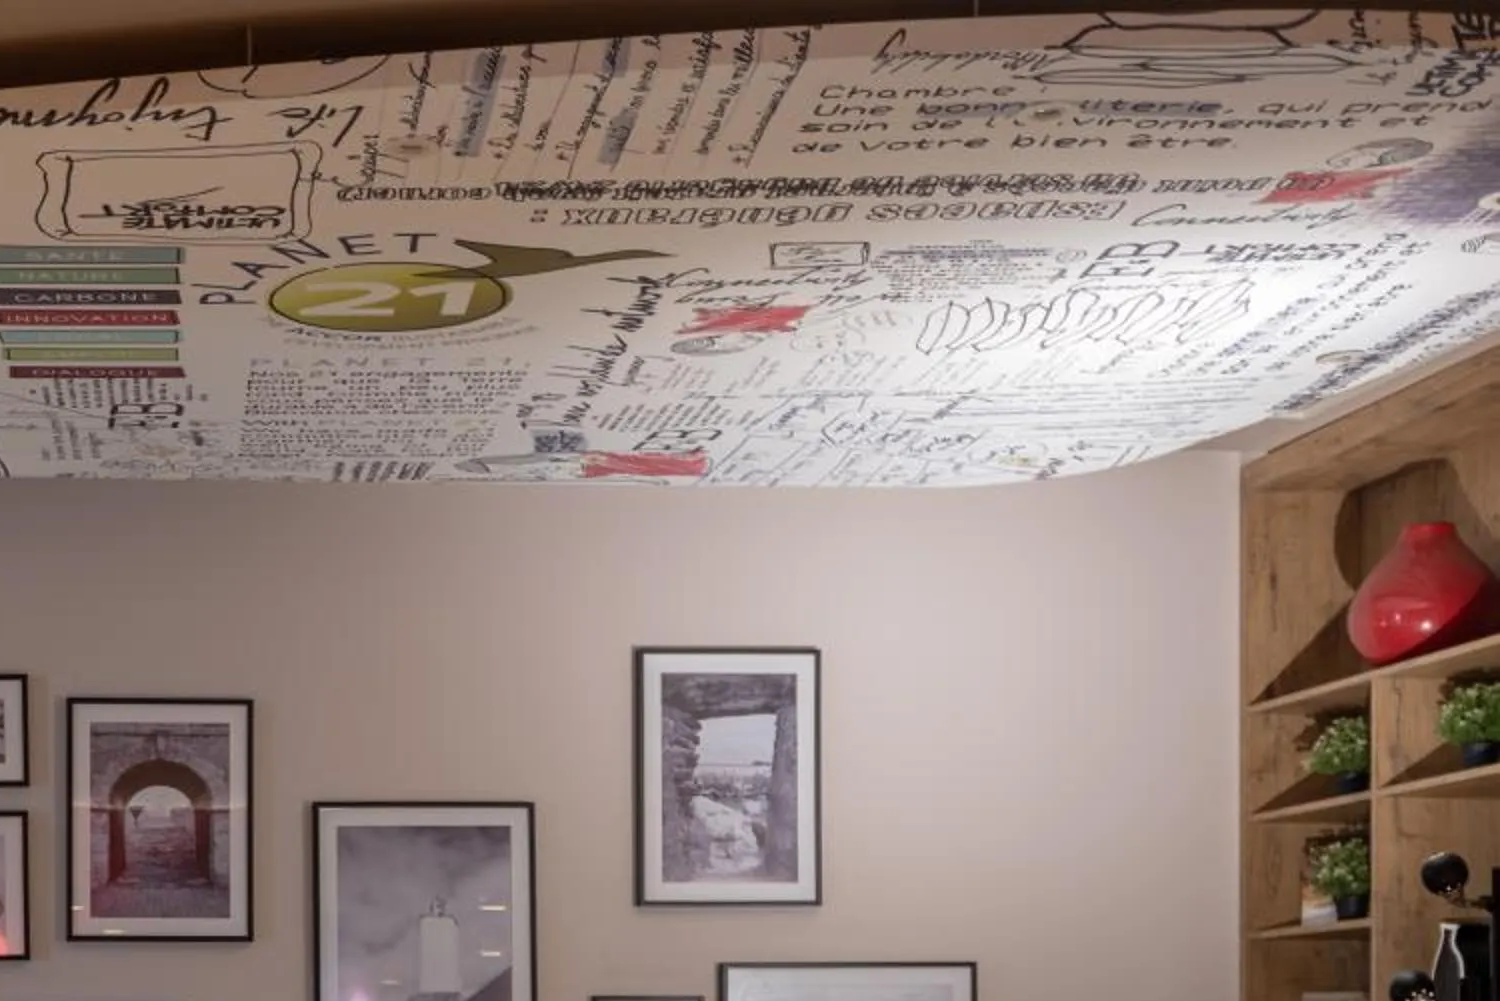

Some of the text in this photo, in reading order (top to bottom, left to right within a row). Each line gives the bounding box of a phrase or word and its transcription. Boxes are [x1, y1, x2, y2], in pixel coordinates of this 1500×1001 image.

[818, 84, 1016, 100] Chambre
[812, 103, 895, 117] Une
[915, 100, 1040, 116] bonn
[1256, 99, 1328, 117] qui
[1338, 99, 1493, 117] prend
[264, 102, 366, 149] Life
[797, 119, 890, 133] soin
[911, 118, 963, 131] de
[1379, 115, 1435, 128] et
[790, 141, 842, 153] de
[1011, 133, 1108, 148] bien
[190, 232, 439, 306] PLANET
[13, 291, 158, 303] CARBONE
[299, 280, 478, 317] 21
[6, 313, 169, 323] INNOVATION
